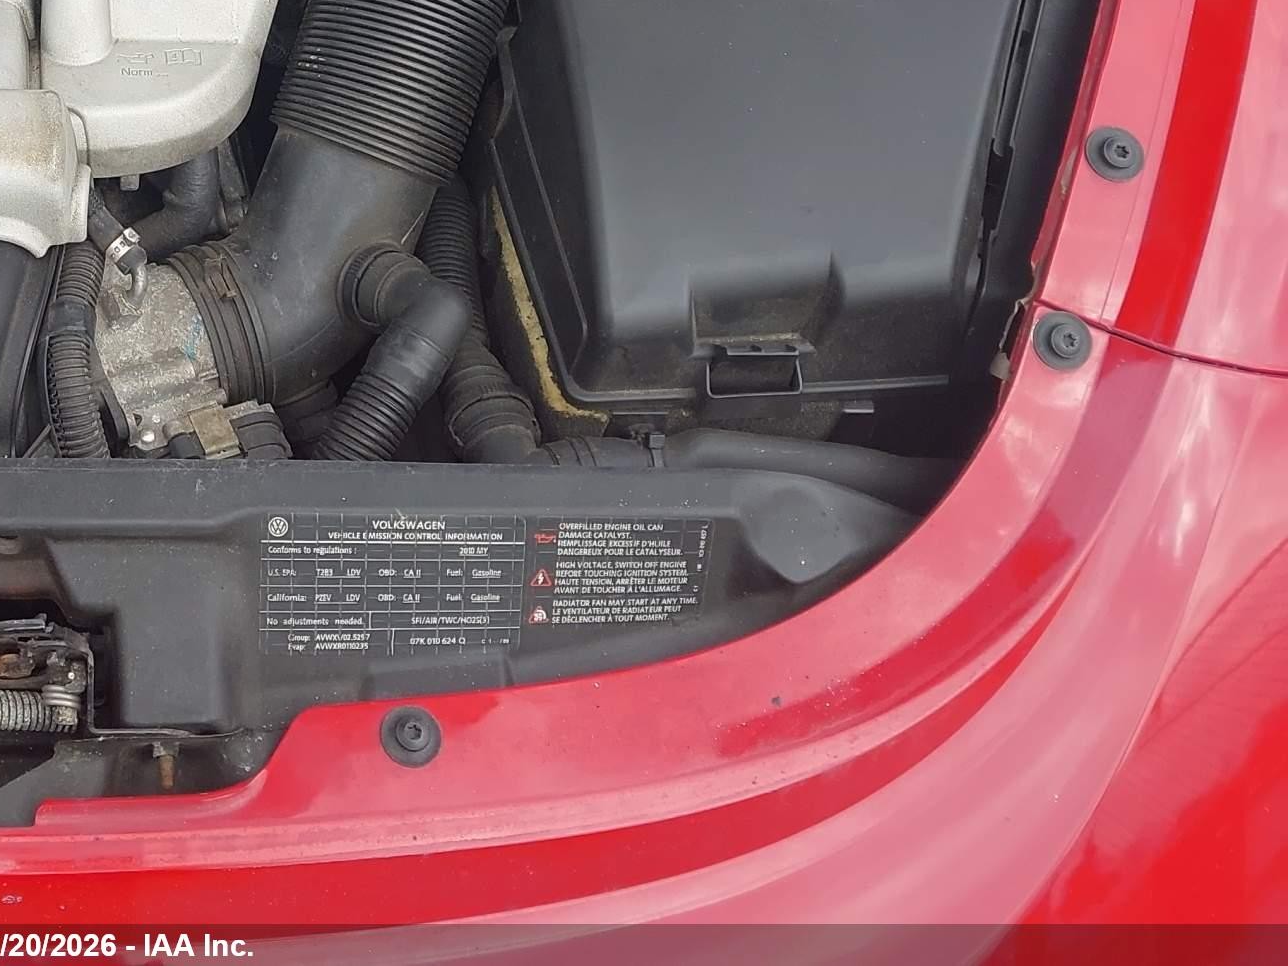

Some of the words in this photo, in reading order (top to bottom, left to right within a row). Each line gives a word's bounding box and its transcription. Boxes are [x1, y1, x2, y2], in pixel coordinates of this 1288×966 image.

[372, 520, 446, 530] VOLKSWAGEN
[559, 522, 602, 530] OVERFILLED
[604, 523, 632, 531] ENGINE
[633, 523, 646, 531] OIL
[362, 532, 403, 540] EMISSION
[404, 532, 441, 540] CONTROL
[445, 533, 503, 541] INFORMATION
[558, 531, 593, 539] DAMAGE
[593, 531, 632, 539] CATALYST.
[558, 539, 607, 547] REMPLISSAGE
[641, 540, 671, 548] D'HUILE
[268, 546, 302, 554] Conforms
[303, 546, 311, 554] to
[313, 546, 353, 556] regulations
[459, 546, 475, 554] 2010
[557, 548, 602, 556] DANGEREUX
[604, 548, 624, 556] POUR
[625, 548, 633, 556] LE
[635, 548, 683, 556] CATALYSEUR.
[556, 561, 576, 569] HIGH
[614, 561, 643, 569] SWITCH
[644, 561, 658, 569] OFF
[659, 561, 687, 569] ENGINE
[378, 569, 397, 577] OBD:
[403, 569, 414, 577] CA
[446, 569, 463, 577] Fuel:
[472, 569, 502, 577] Gasoline
[555, 569, 582, 577] BEFORE
[584, 569, 622, 577] TOUCHING
[624, 569, 657, 577] IGNITION
[658, 569, 688, 577] SYSTEM.
[554, 578, 580, 586] HAUTE
[647, 577, 656, 585] LE
[657, 577, 688, 585] MOTEUR
[554, 586, 580, 594] AVANT
[581, 586, 591, 594] DE
[593, 586, 626, 594] TOUCHER
[267, 594, 306, 602] California:
[346, 594, 360, 602] LDV
[470, 593, 500, 601] Gasoline
[552, 599, 591, 607] RADIATOR
[592, 599, 607, 607] FAN
[627, 598, 649, 606] START
[662, 597, 679, 605] ANY
[680, 596, 699, 604] TIME.
[552, 607, 561, 615] LE
[562, 607, 610, 615] VENTILATEUR
[622, 606, 663, 614] RADIATEUR
[664, 605, 682, 613] PEUT
[283, 618, 329, 626] adjustments
[552, 616, 561, 624] SE
[634, 614, 670, 622] MOMENT.
